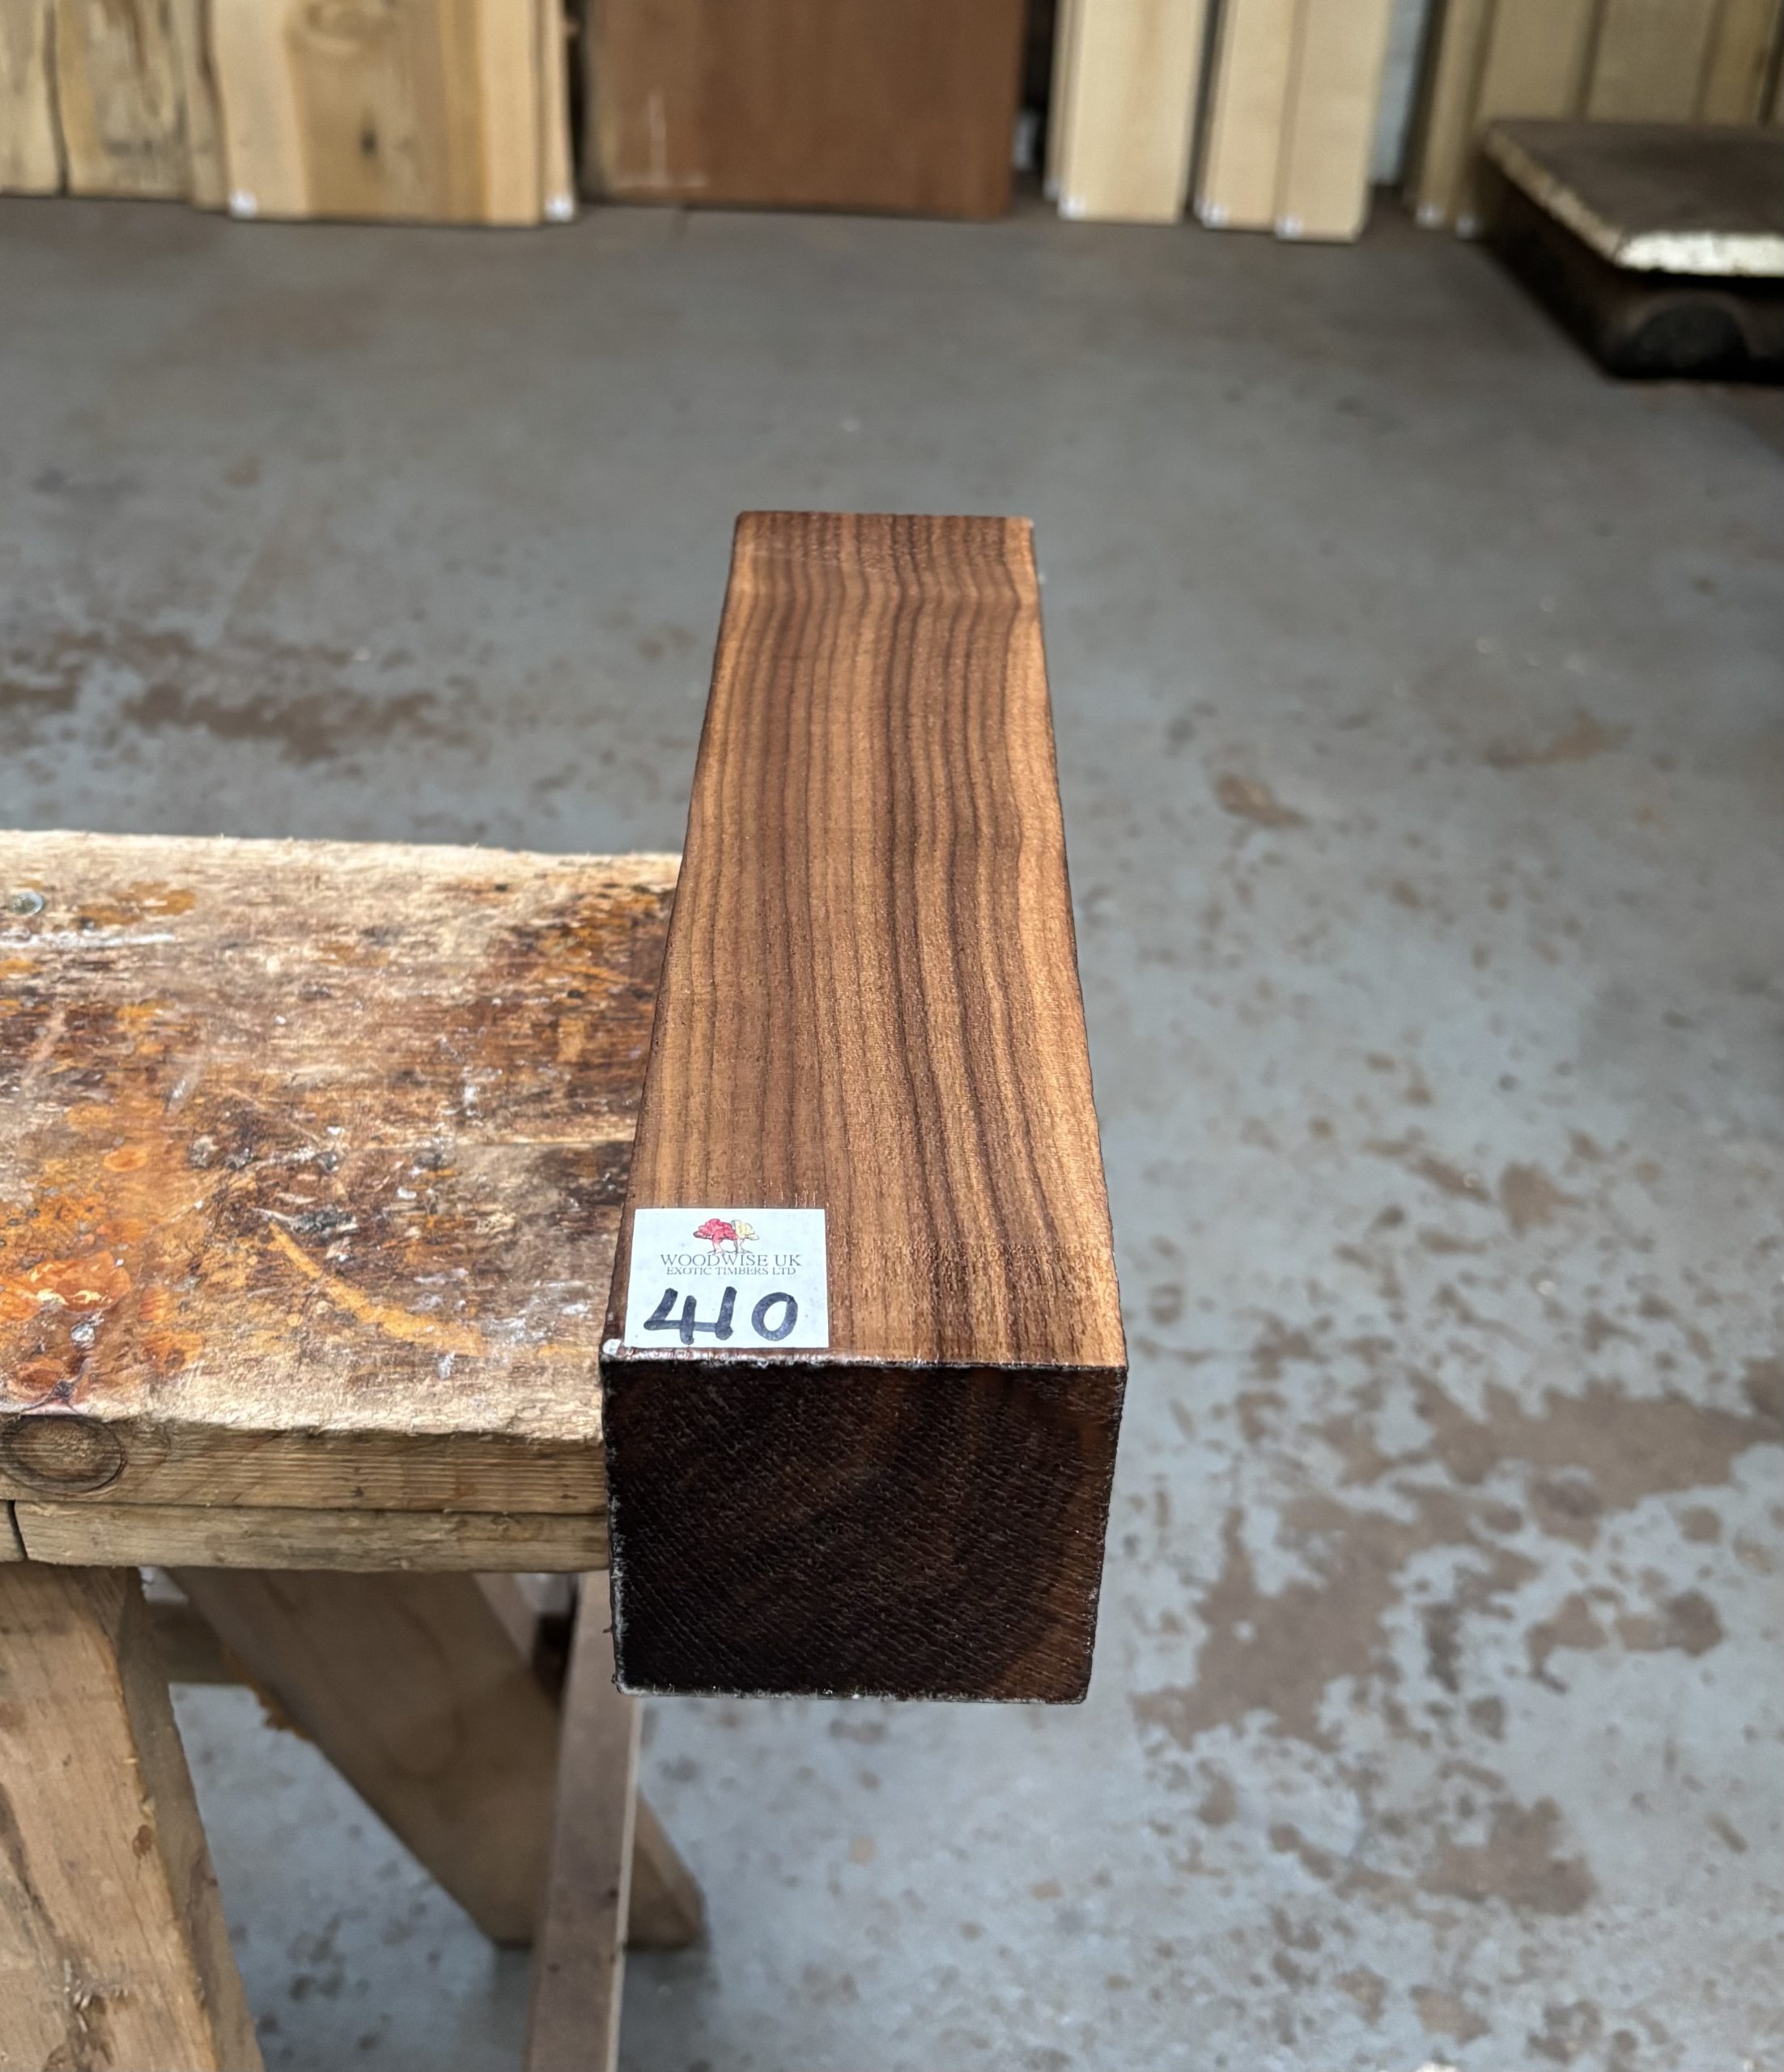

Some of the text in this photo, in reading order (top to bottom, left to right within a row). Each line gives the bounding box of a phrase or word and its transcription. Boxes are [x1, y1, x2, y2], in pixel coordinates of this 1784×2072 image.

[661, 1254, 802, 1267] WOODWISE UK
[666, 1267, 796, 1276] EXOTIC TIMBERS LTD
[644, 1286, 798, 1345] 410
